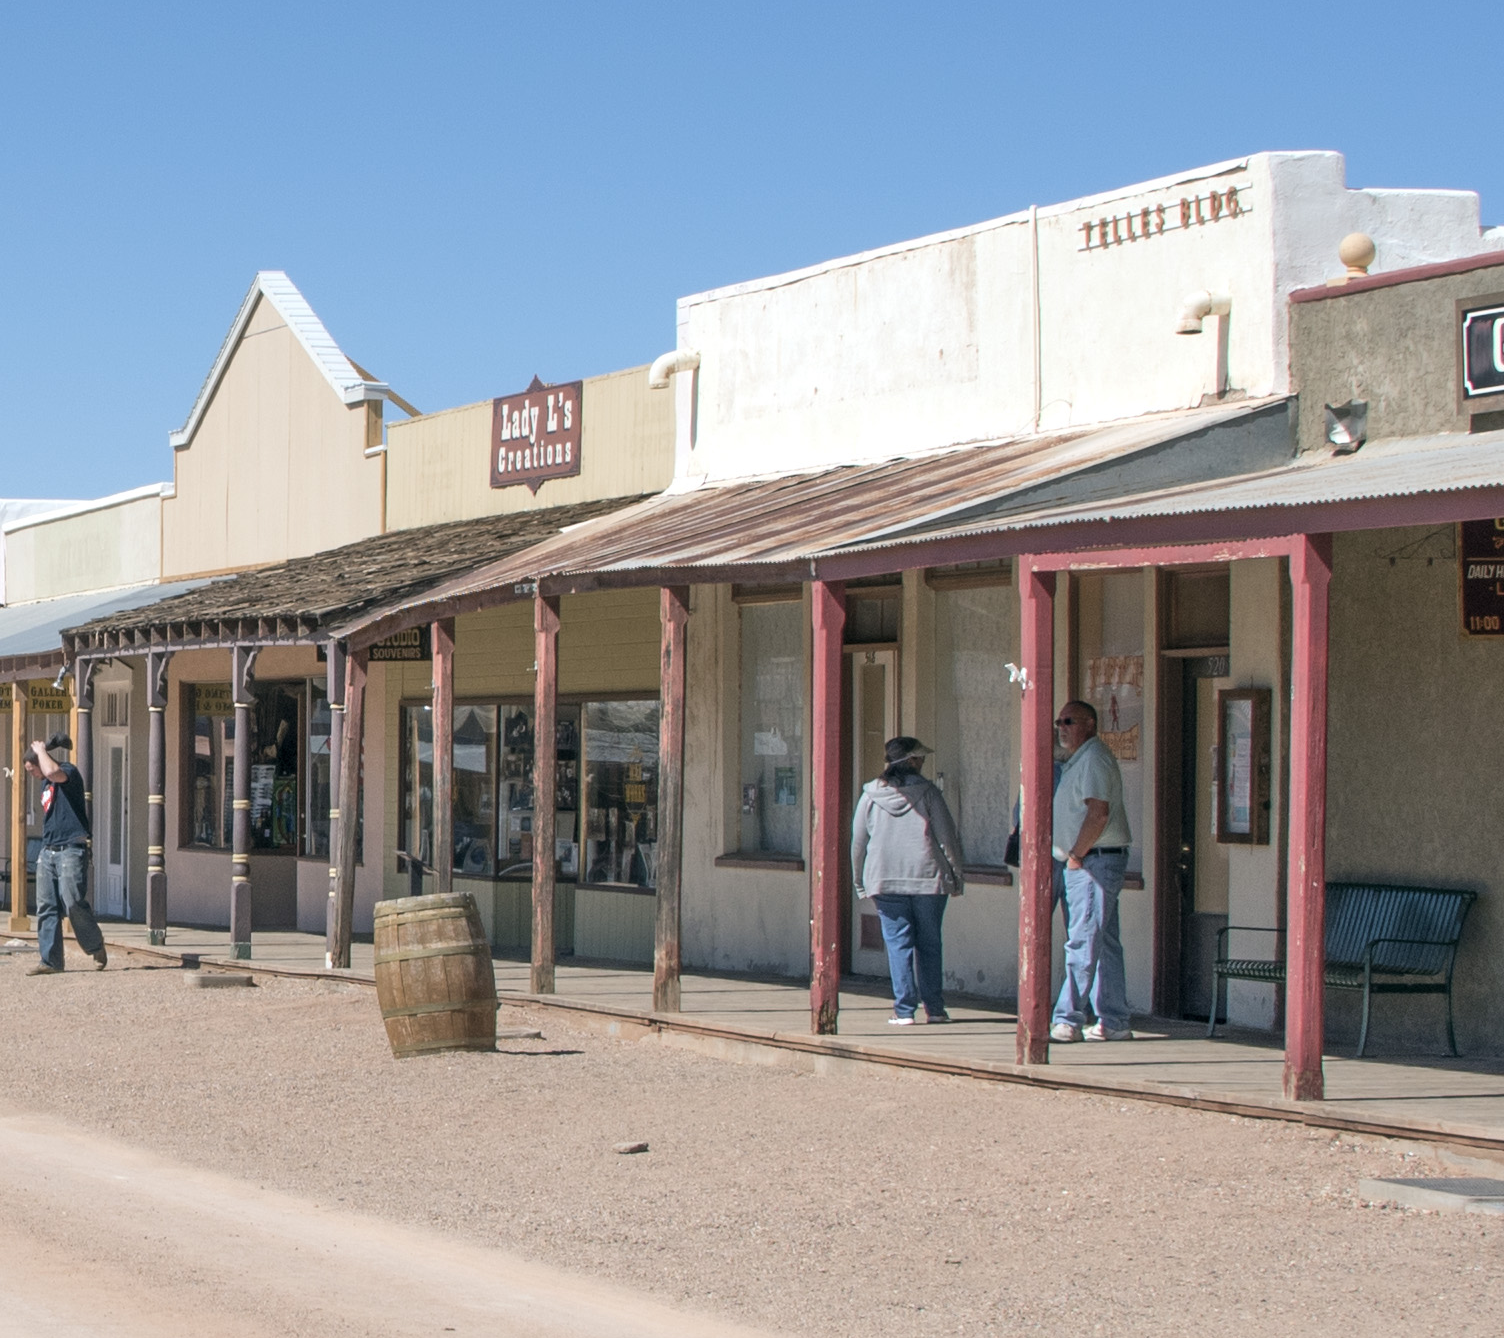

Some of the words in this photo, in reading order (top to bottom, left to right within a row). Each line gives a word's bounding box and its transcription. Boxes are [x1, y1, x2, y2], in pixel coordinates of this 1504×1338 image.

[1083, 203, 1166, 254] TELLES
[1180, 185, 1245, 230] BLDG.
[501, 398, 540, 445] Lady
[547, 392, 573, 433] L's
[498, 440, 572, 474] Creations
[1467, 564, 1495, 579] DAILY
[377, 628, 421, 647] UDIO
[373, 646, 422, 660] SOUVENIRS
[31, 686, 71, 698] GALLER
[32, 699, 64, 710] POKER
